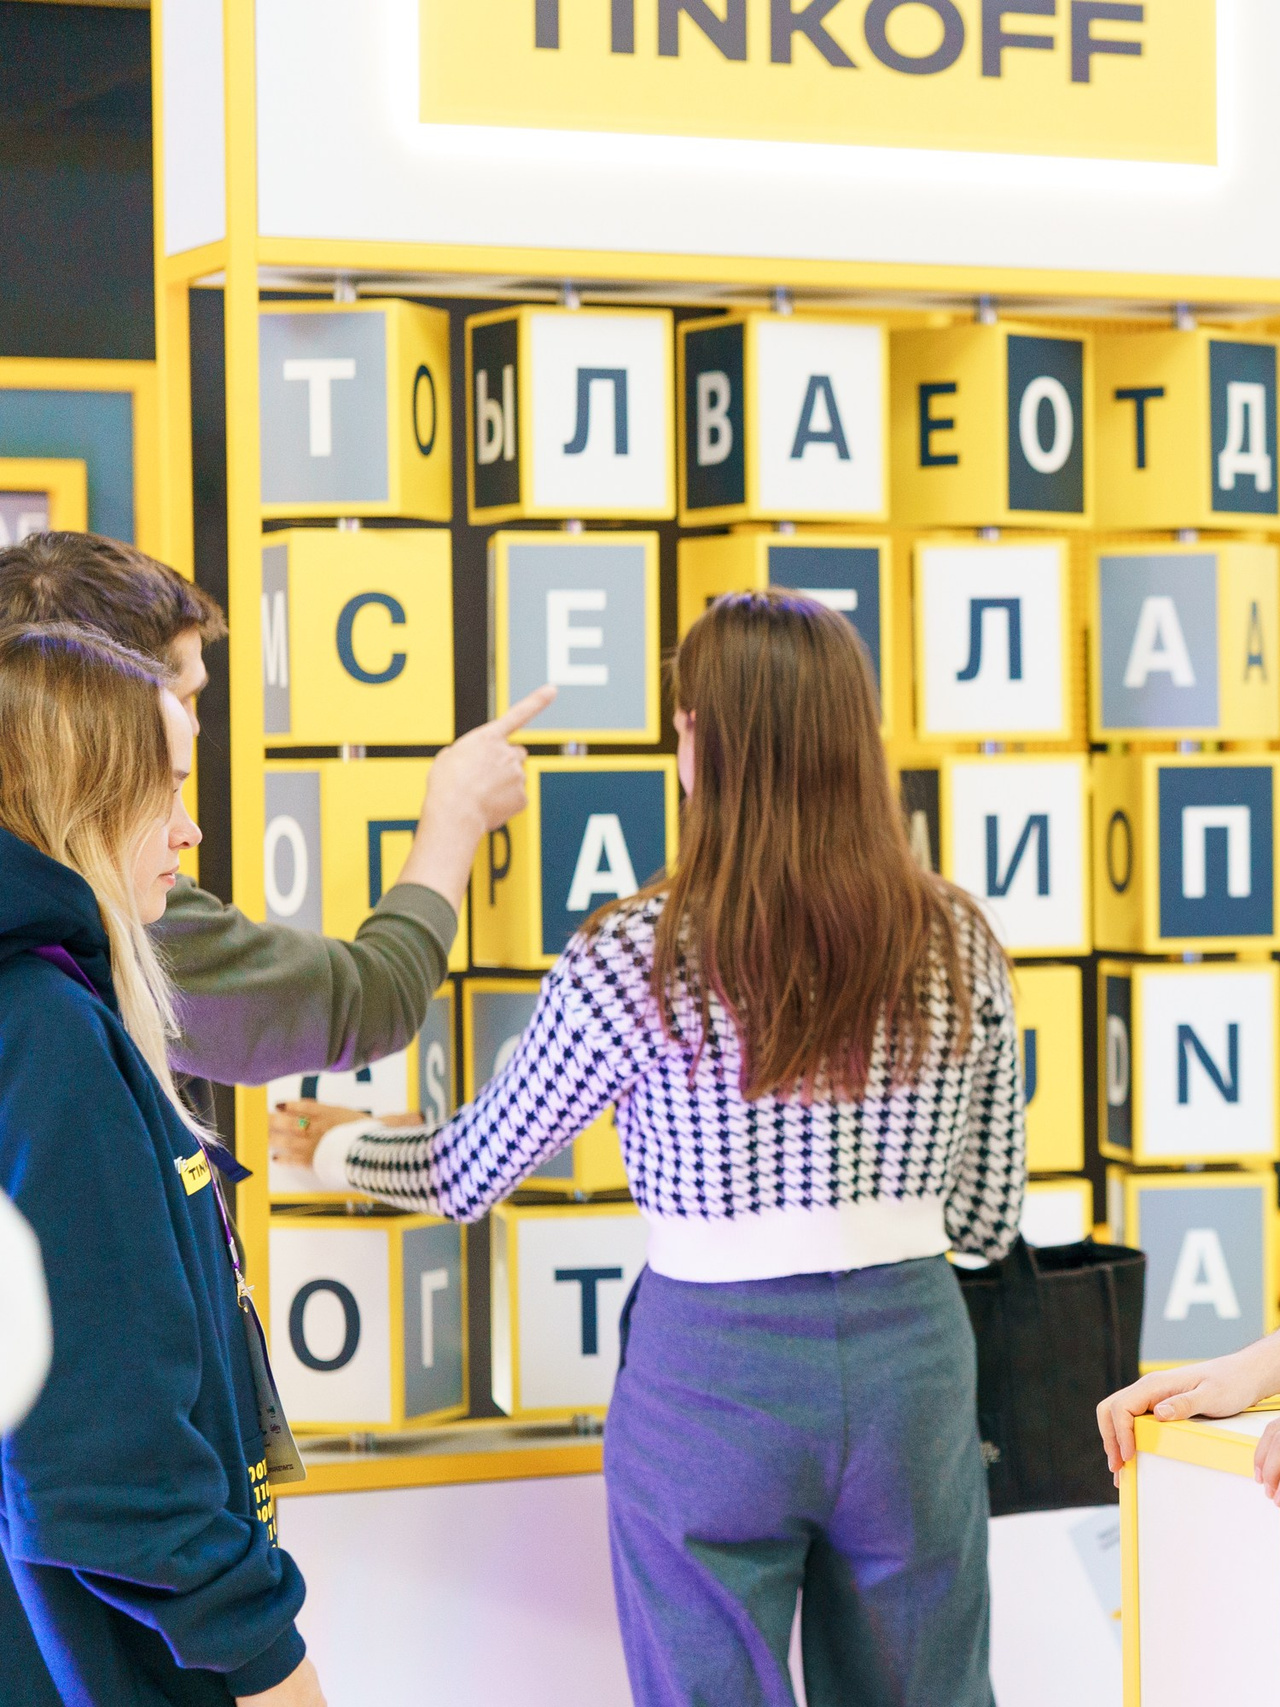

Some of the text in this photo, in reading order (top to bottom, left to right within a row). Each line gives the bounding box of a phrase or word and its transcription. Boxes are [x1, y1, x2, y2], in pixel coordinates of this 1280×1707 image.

[283, 359, 1273, 494] Т О Ы Л В А Е О Т Д
[336, 592, 407, 684] С
[546, 589, 608, 685] Е
[955, 597, 1023, 682] Л
[1123, 596, 1196, 689] А
[1244, 600, 1268, 683] А
[263, 815, 308, 917] О
[566, 813, 640, 912] А
[985, 814, 1051, 898] И
[1106, 809, 1134, 895] О
[1181, 804, 1251, 899] П
[1177, 1023, 1239, 1105] N
[287, 1278, 362, 1373] О
[554, 1267, 623, 1356] Т
[1163, 1228, 1241, 1319] А
